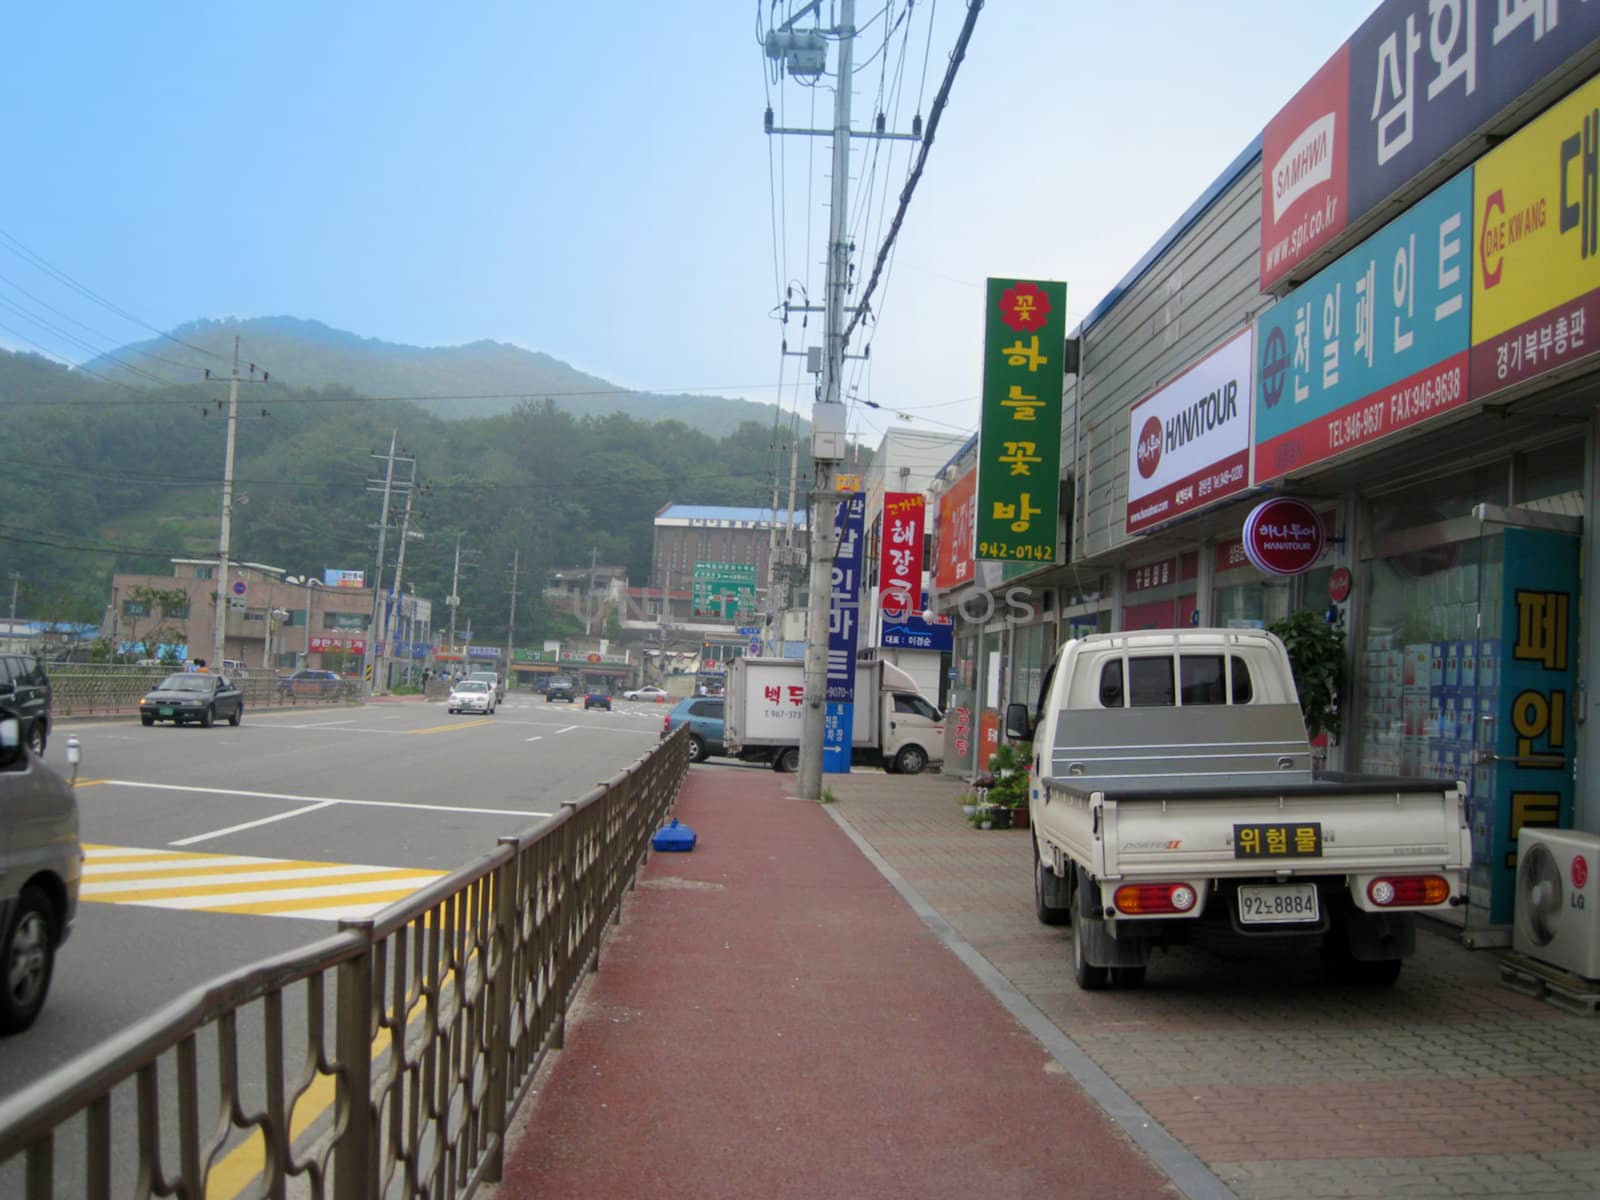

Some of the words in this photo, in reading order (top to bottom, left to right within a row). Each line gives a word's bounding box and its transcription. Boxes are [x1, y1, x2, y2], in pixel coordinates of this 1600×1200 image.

[1276, 131, 1329, 199] SAMHWA
[1265, 195, 1338, 273] www.spi.co.kr
[1486, 222, 1505, 257] DAE
[1507, 198, 1547, 246] KWANG
[1013, 294, 1037, 321] 꽃
[1293, 211, 1463, 405] 천일페인트
[1496, 306, 1586, 380] 경기북부총판
[1164, 379, 1238, 454] HANATOUR
[979, 541, 1052, 560] 942-0742
[1259, 523, 1316, 541] 하나투어
[1263, 541, 1312, 551] HANATOUR
[1508, 590, 1570, 869] 페인트
[1239, 827, 1318, 855] 위험물
[1243, 891, 1314, 917] 92노8884
[1570, 892, 1585, 910] LG
